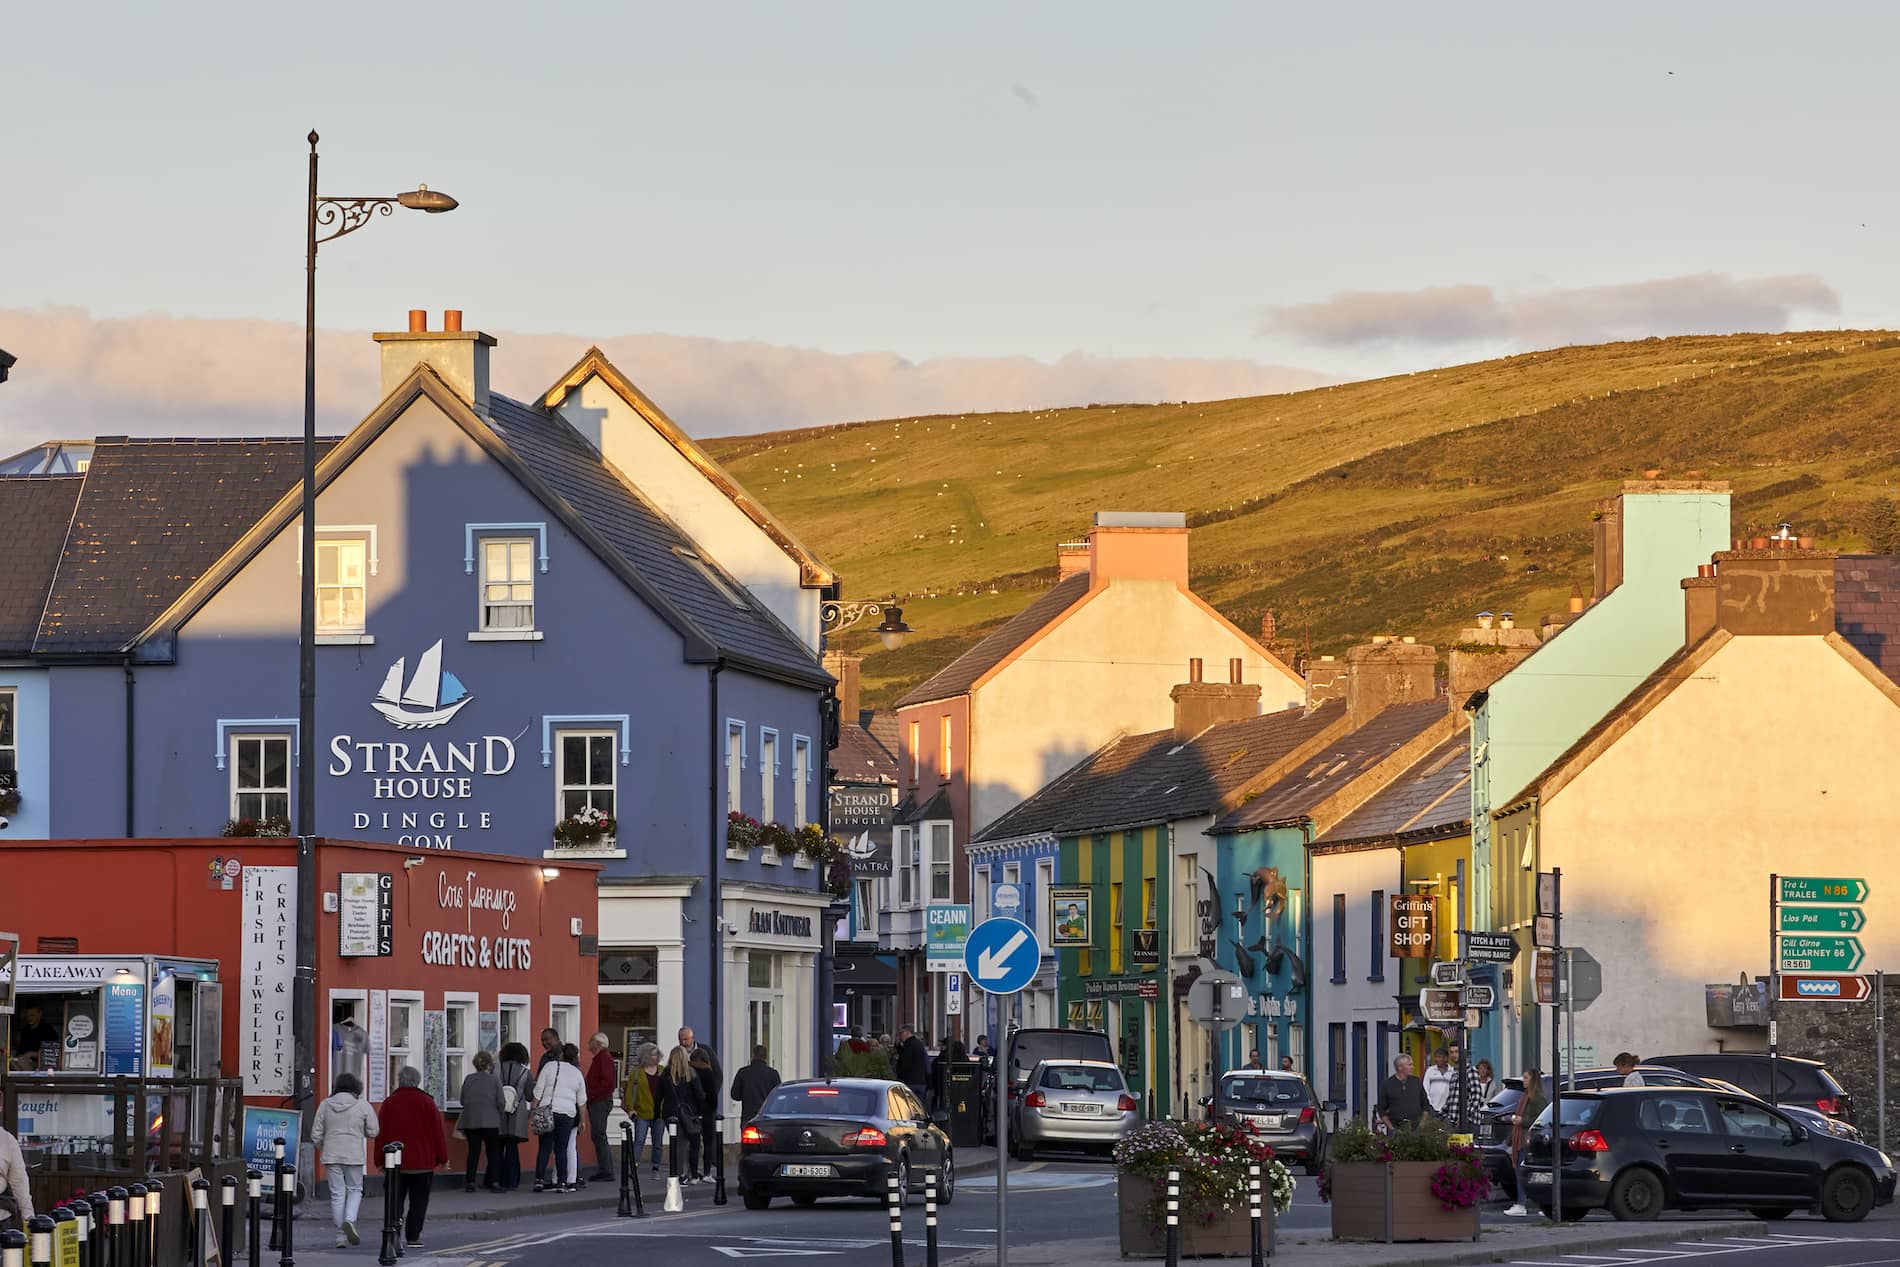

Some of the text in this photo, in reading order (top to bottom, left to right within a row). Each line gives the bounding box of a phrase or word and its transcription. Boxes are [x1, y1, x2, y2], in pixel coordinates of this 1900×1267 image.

[330, 735, 516, 777] STRAND
[374, 778, 472, 799] HOUSE
[835, 793, 890, 807] STRAND
[845, 806, 881, 816] HOUSE
[353, 812, 491, 829] DINGLE
[835, 817, 886, 825] DINGLE
[1784, 890, 1816, 898] TRALEE
[1824, 885, 1848, 895] N 86
[1394, 899, 1433, 912] Griffin's
[380, 876, 392, 953] GIFTS
[748, 907, 772, 934] ARAN
[930, 909, 967, 925] CEANN
[1398, 916, 1428, 929] GIFT
[1394, 932, 1432, 946] SHOP
[1470, 935, 1488, 946] PITCH
[1495, 936, 1511, 946] PUTT
[421, 931, 532, 970] CRAFTS & GIFTS
[1470, 950, 1492, 959] DRIVING
[1783, 949, 1830, 957] KILLARNEY
[252, 876, 265, 1085] IRISH JEWELLERY
[274, 883, 287, 1078] CRAFTS & GIFTS
[112, 985, 137, 997] Menu
[256, 1124, 287, 1138] Anchor
[256, 1138, 276, 1152] DOW
